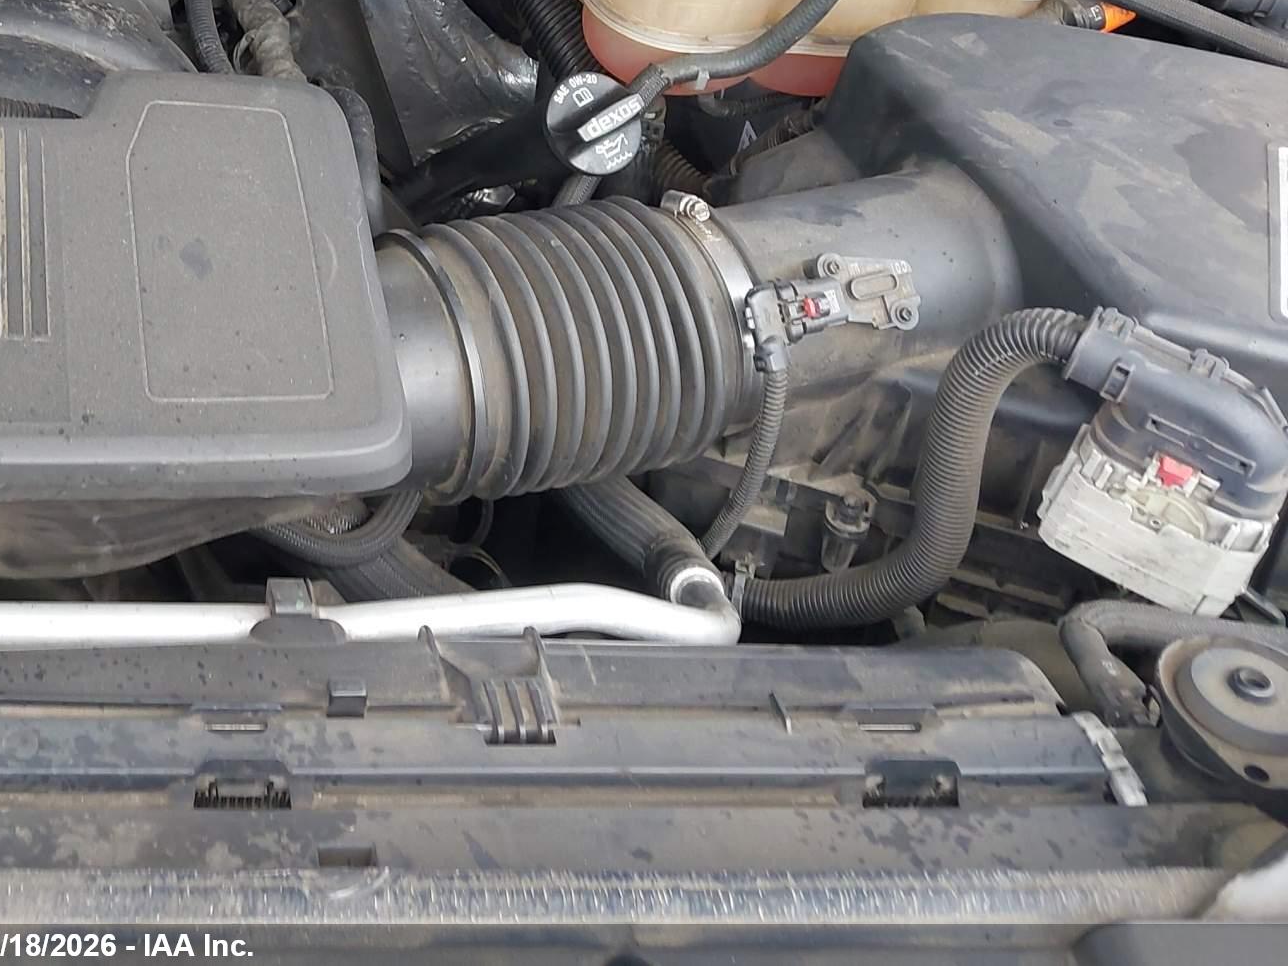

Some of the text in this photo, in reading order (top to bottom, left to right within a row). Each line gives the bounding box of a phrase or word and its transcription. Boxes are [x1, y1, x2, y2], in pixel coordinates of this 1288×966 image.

[553, 74, 598, 105] SAE 0W-20
[586, 96, 642, 138] dexos
